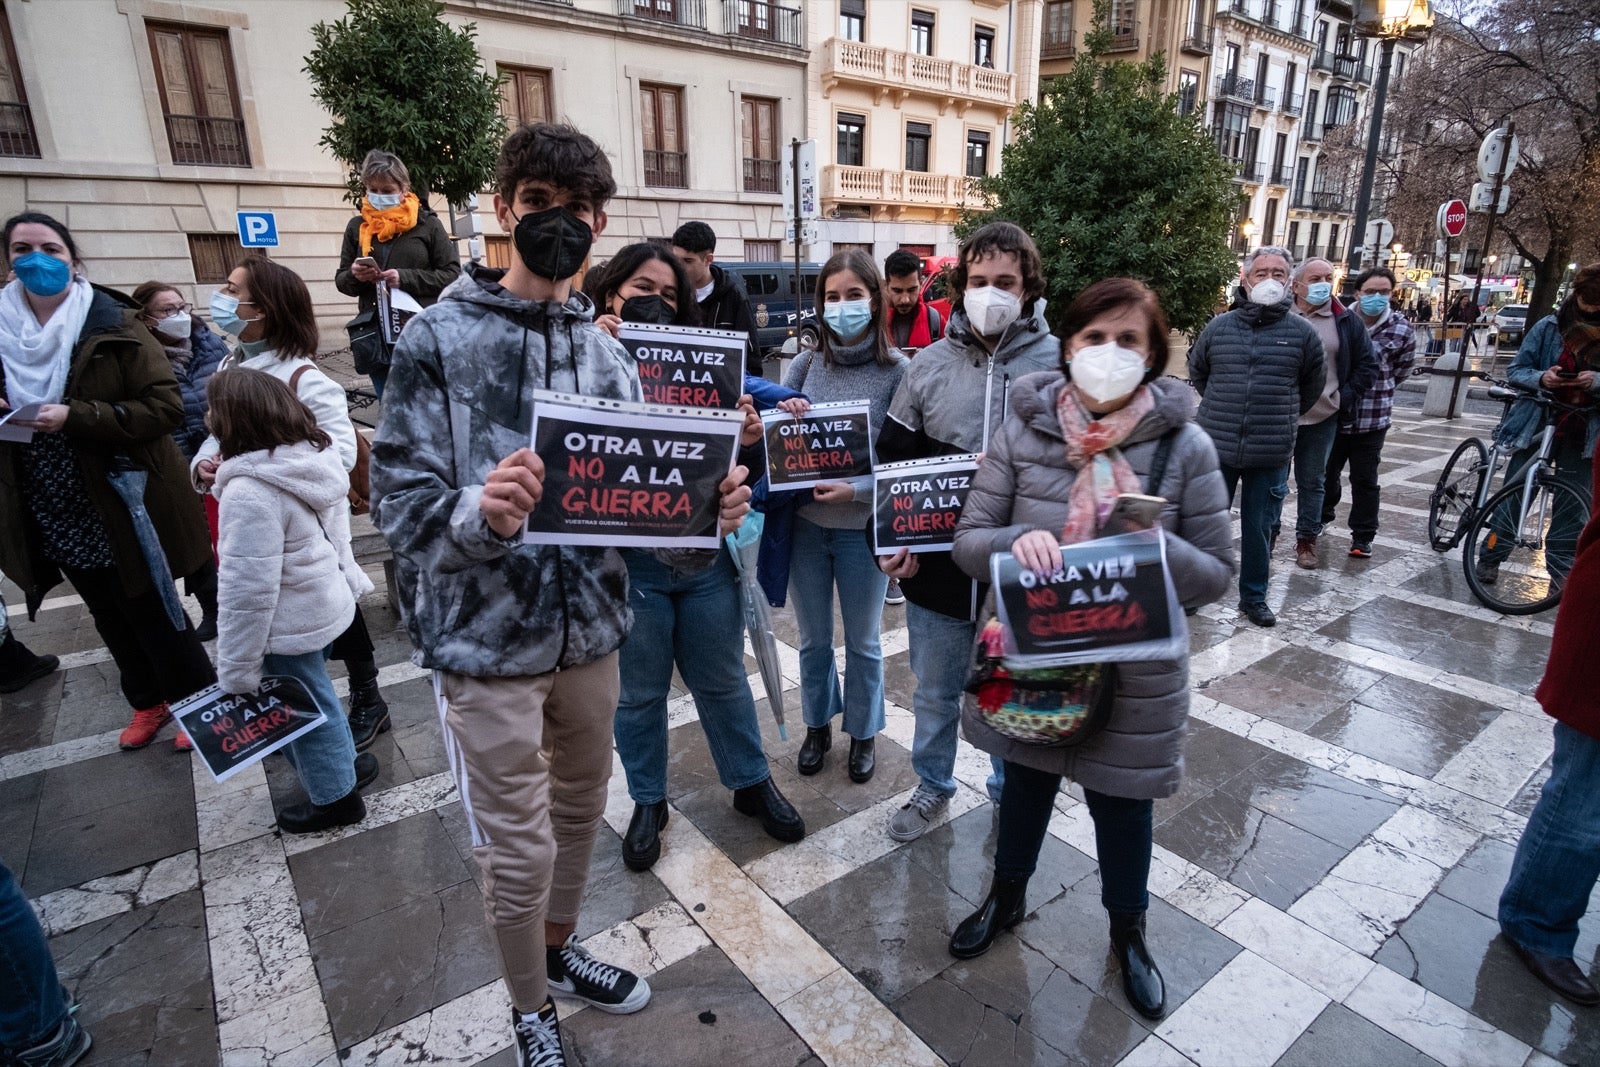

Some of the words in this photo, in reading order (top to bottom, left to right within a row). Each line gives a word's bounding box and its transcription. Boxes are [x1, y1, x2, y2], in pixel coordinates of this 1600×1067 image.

[1448, 213, 1465, 223] STOP
[245, 216, 269, 243] P
[787, 307, 817, 324] POLI
[636, 346, 686, 363] OTRA
[691, 351, 725, 366] VEZ
[639, 362, 662, 379] NO
[672, 369, 686, 382] A
[690, 370, 714, 384] LA
[779, 422, 820, 436] OTRA
[823, 420, 853, 433] VEZ
[564, 432, 643, 456] OTRA
[653, 439, 706, 460] VEZ
[784, 437, 803, 451] NO
[811, 438, 822, 449] A
[825, 437, 845, 448] LA
[568, 455, 605, 482] NO
[620, 465, 640, 483] A
[649, 466, 684, 486] LA
[784, 450, 854, 471] GUERRA
[890, 480, 933, 494] OTRA
[936, 476, 970, 490] VEZ
[561, 486, 693, 519] GUERRA
[893, 495, 913, 511] NO
[922, 497, 935, 509] A
[938, 495, 961, 508] LA
[565, 518, 598, 526] VUESTRAS
[893, 511, 957, 533] GUERR
[1087, 554, 1137, 580] VEZ
[1025, 587, 1059, 609] NO
[1068, 587, 1091, 605] A
[1092, 581, 1130, 603] LA
[200, 694, 248, 723] OTRA
[210, 715, 234, 736] NO
[243, 708, 257, 721] A
[257, 695, 282, 713] LA
